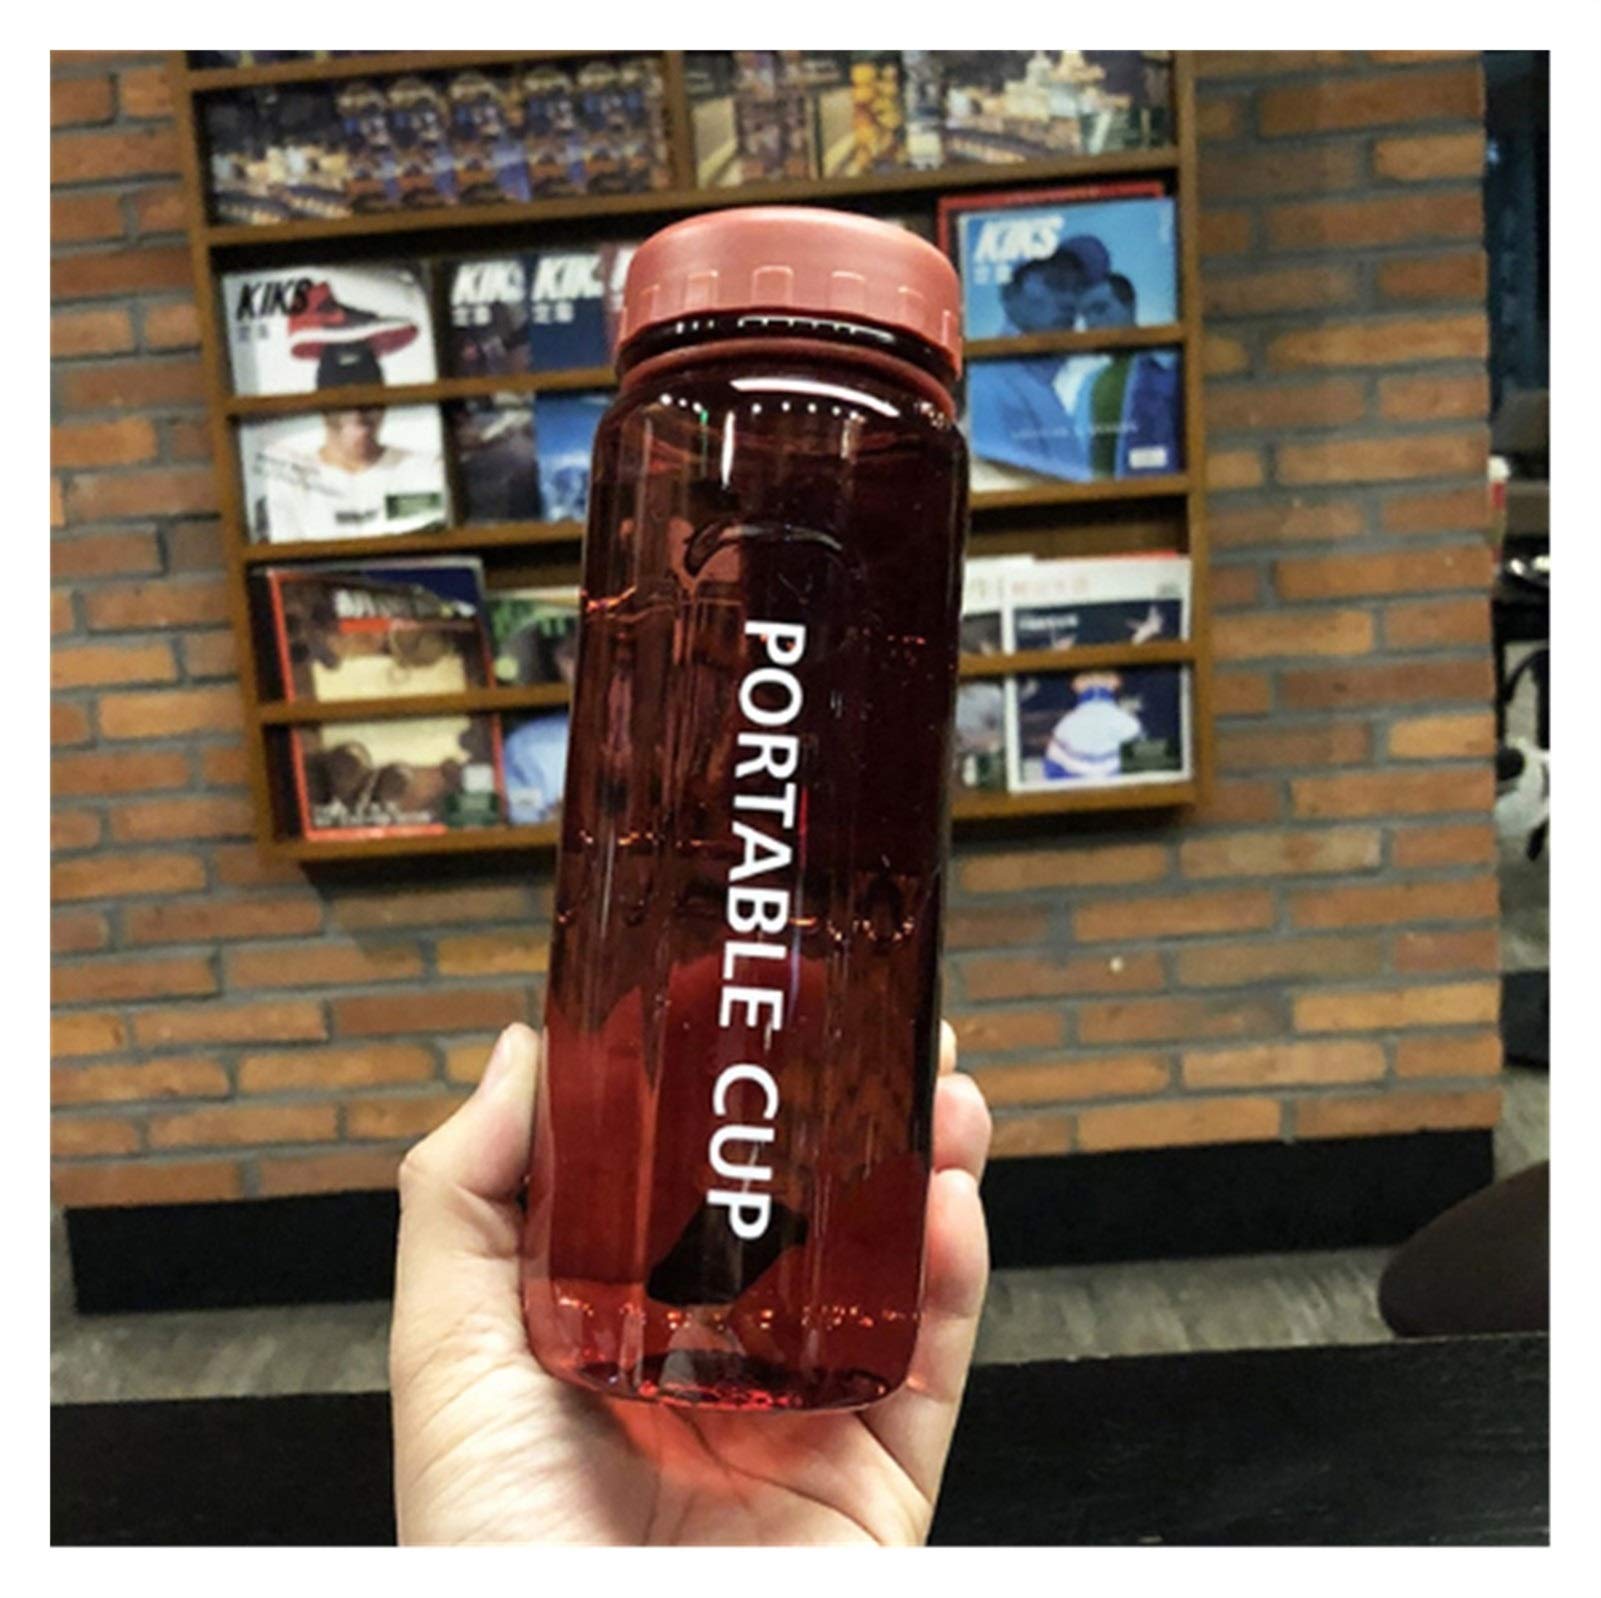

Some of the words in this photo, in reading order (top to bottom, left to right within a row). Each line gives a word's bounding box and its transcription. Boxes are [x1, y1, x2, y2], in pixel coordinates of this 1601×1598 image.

[973, 216, 1065, 262] KIKS
[236, 278, 314, 321] KIKS
[719, 620, 806, 1036] PORTABLE
[707, 1063, 779, 1239] CUP
